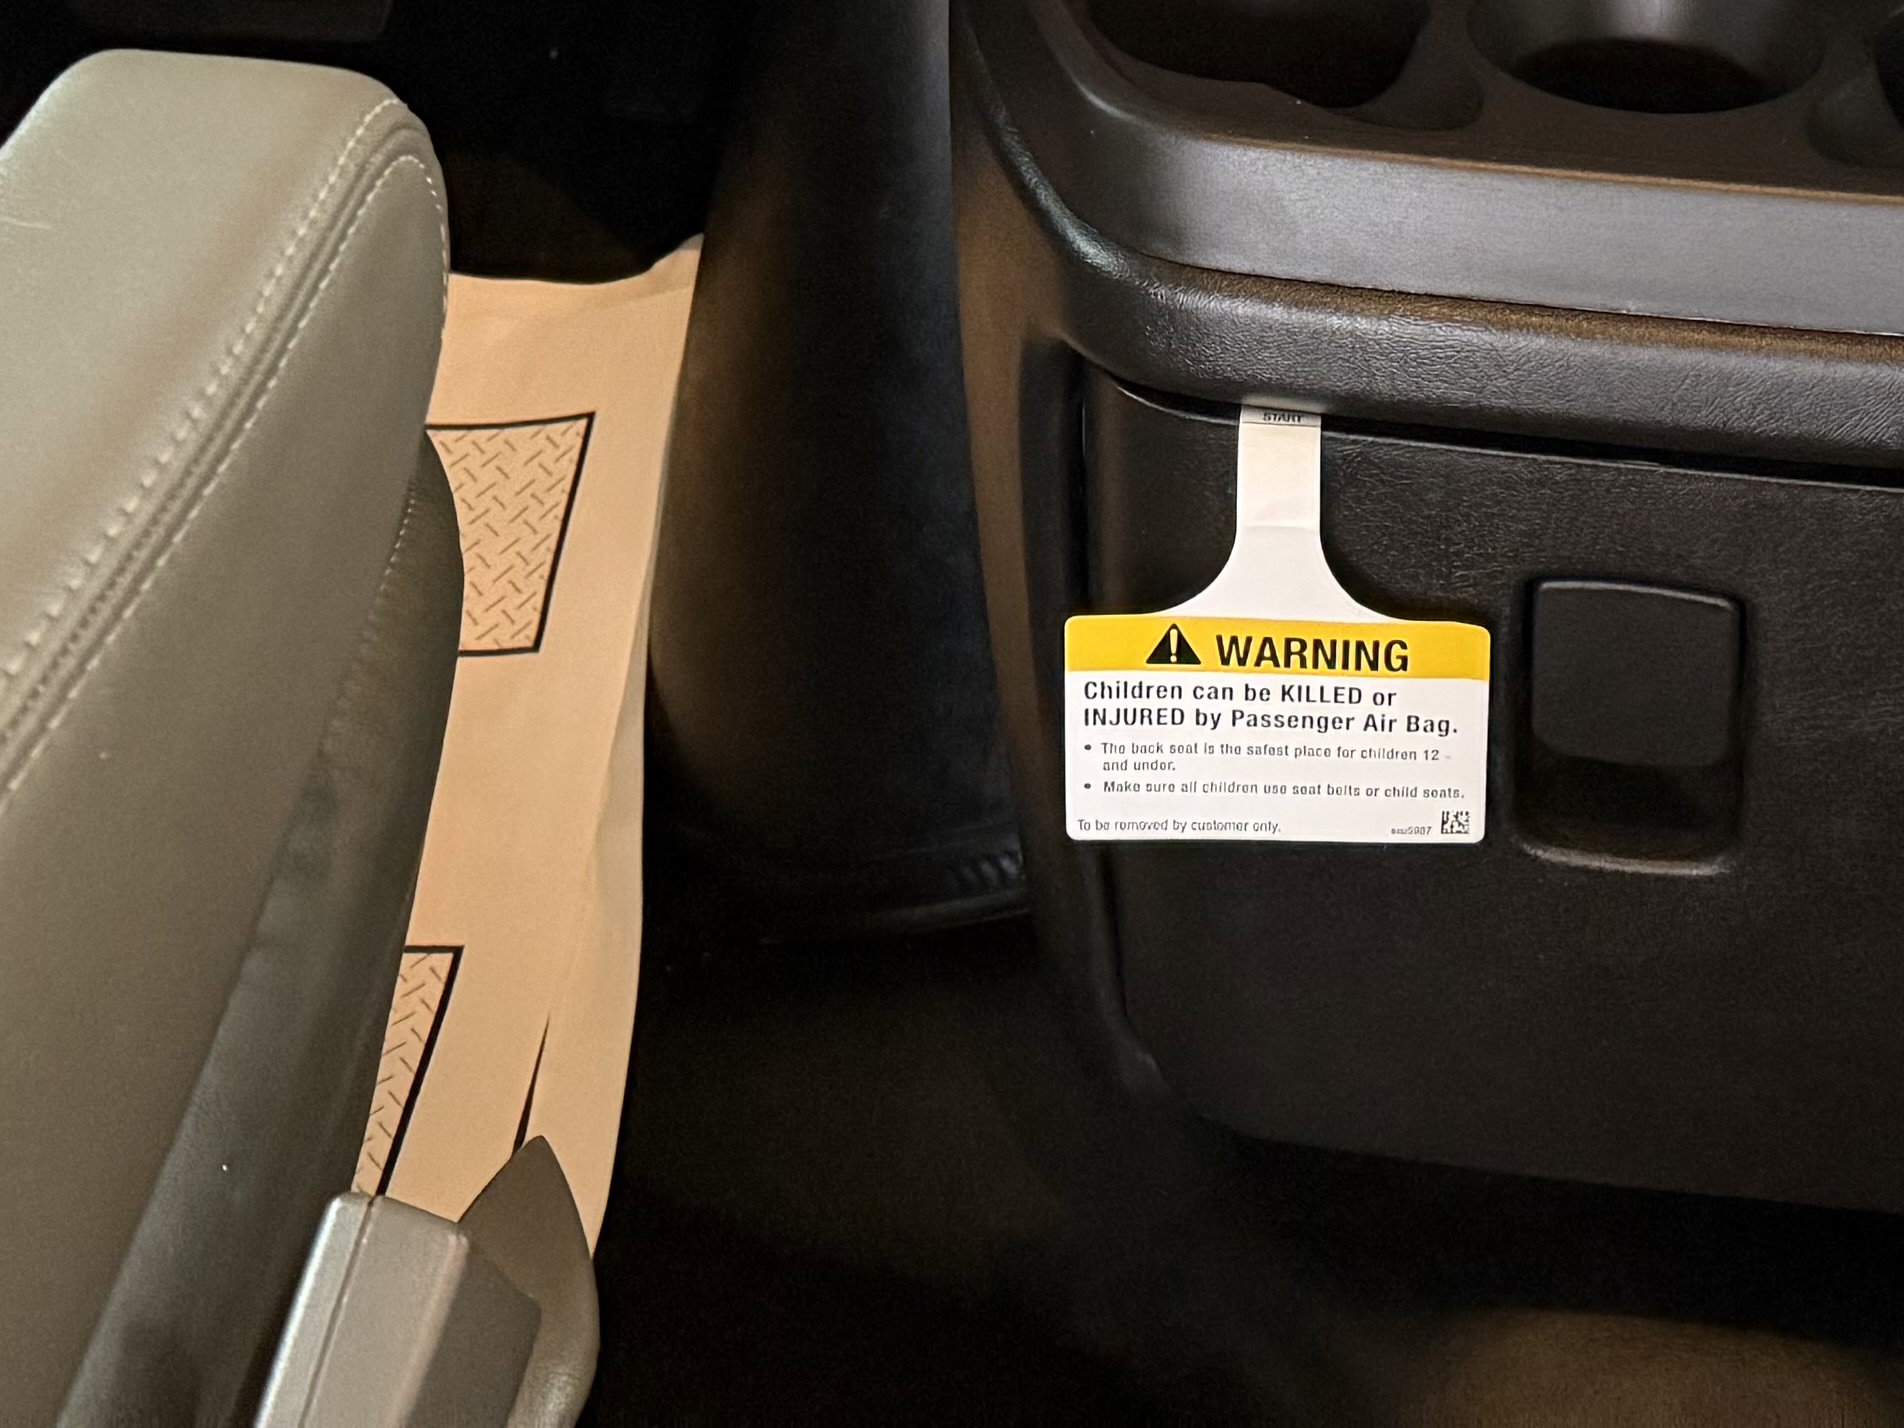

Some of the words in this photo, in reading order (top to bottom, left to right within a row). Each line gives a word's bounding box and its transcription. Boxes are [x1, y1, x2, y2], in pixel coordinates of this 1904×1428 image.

[1215, 634, 1409, 672] WARNING
[1084, 680, 1183, 700] Children
[1192, 685, 1234, 701] can
[1244, 683, 1271, 702] be
[1281, 684, 1363, 705] KILLED
[1372, 691, 1397, 707] or
[1084, 707, 1185, 726] INJURED
[1195, 707, 1222, 730] by
[1231, 709, 1356, 734] Passenger
[1363, 713, 1398, 733] Air
[1406, 714, 1458, 738] Bag.
[1101, 742, 1125, 755] The
[1131, 742, 1164, 755] back
[1169, 742, 1199, 755] seat
[1203, 742, 1215, 755] is
[1220, 743, 1242, 755] the
[1246, 743, 1289, 756] safest
[1294, 745, 1331, 759] place
[1337, 746, 1356, 759] for
[1360, 747, 1417, 761] children
[1423, 749, 1440, 761] 12
[1102, 760, 1128, 771] and
[1103, 781, 1141, 793] Make
[1181, 781, 1197, 793] all
[1202, 781, 1258, 794] children
[1263, 784, 1287, 795] use
[1292, 784, 1322, 796] seat
[1327, 784, 1361, 797] belts
[1365, 788, 1380, 797] or
[1384, 786, 1418, 798] child
[1077, 819, 1091, 831] To
[1095, 819, 1110, 831] be
[1114, 819, 1169, 831] removed
[1173, 819, 1188, 834] by
[1190, 821, 1250, 832] customer
